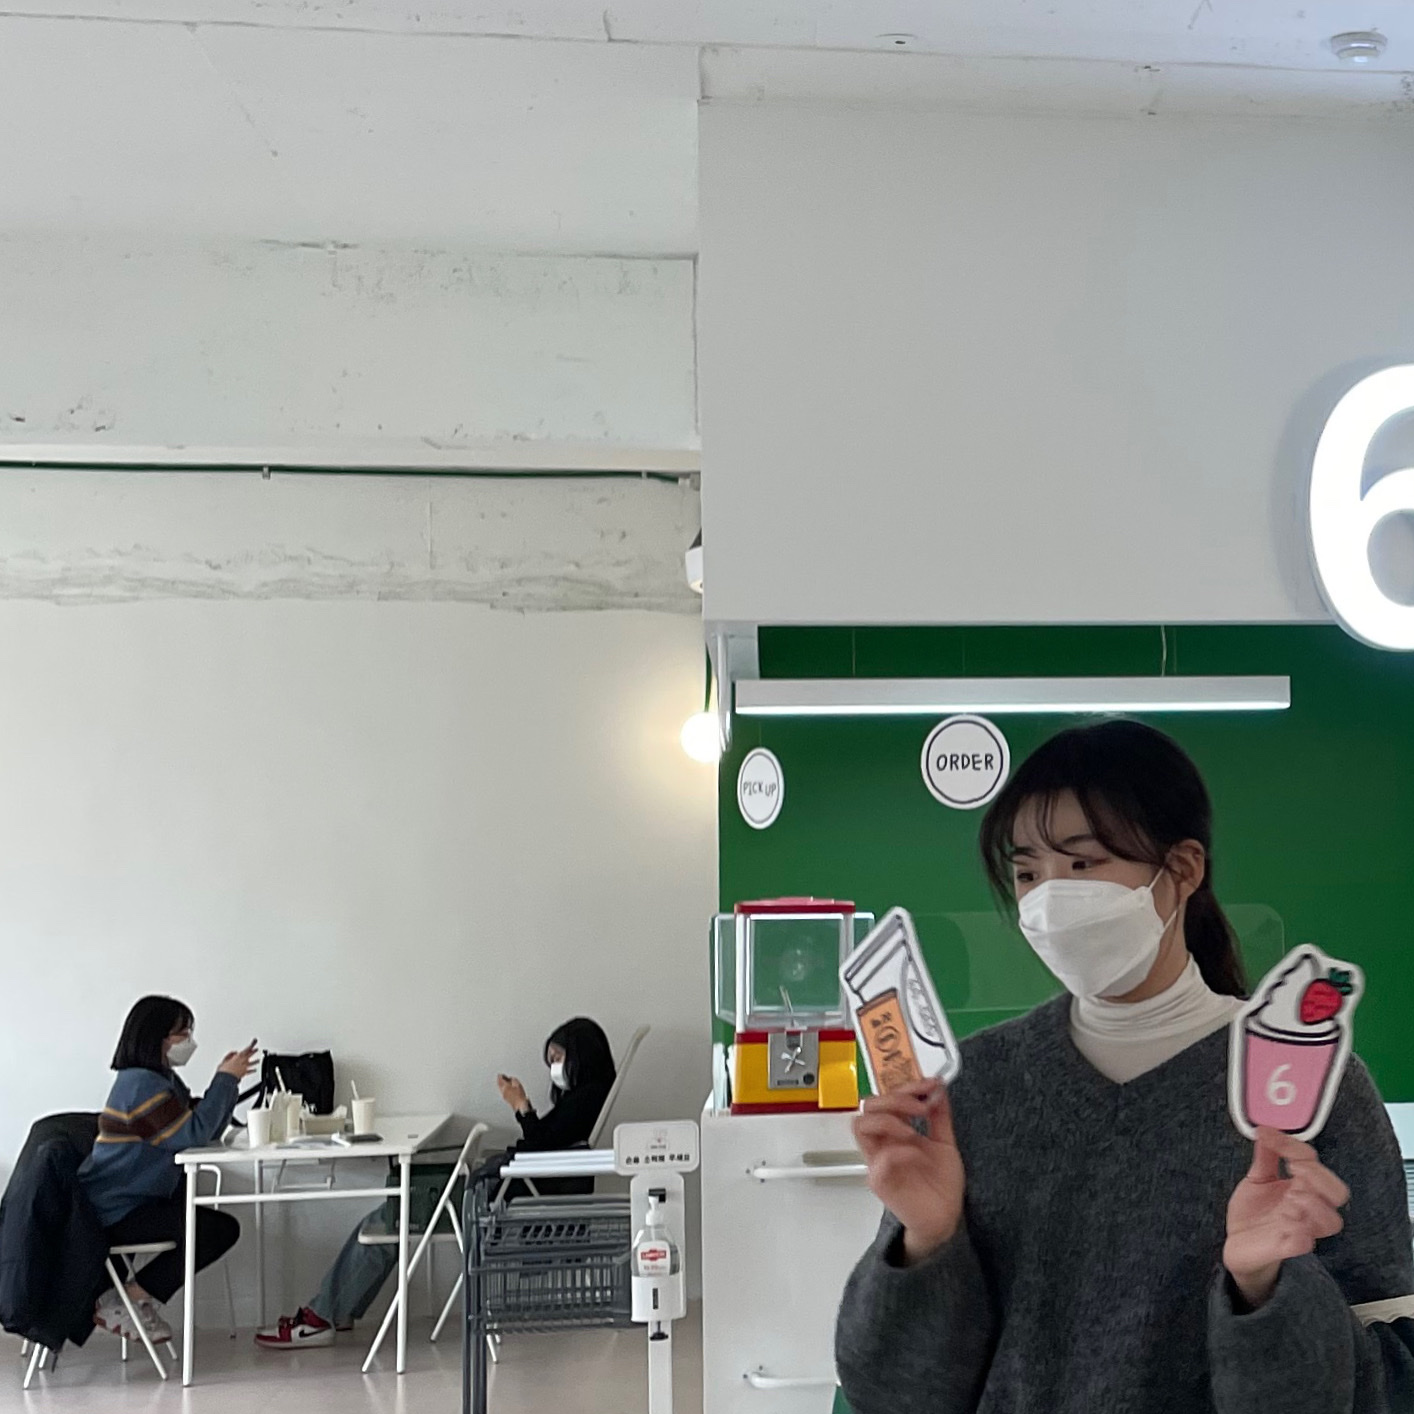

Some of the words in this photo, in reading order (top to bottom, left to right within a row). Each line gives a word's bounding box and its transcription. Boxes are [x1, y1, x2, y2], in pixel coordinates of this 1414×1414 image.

[936, 753, 994, 771] ORDER
[743, 782, 763, 796] PICK
[765, 783, 777, 797] UP
[1267, 1063, 1296, 1106] 6
